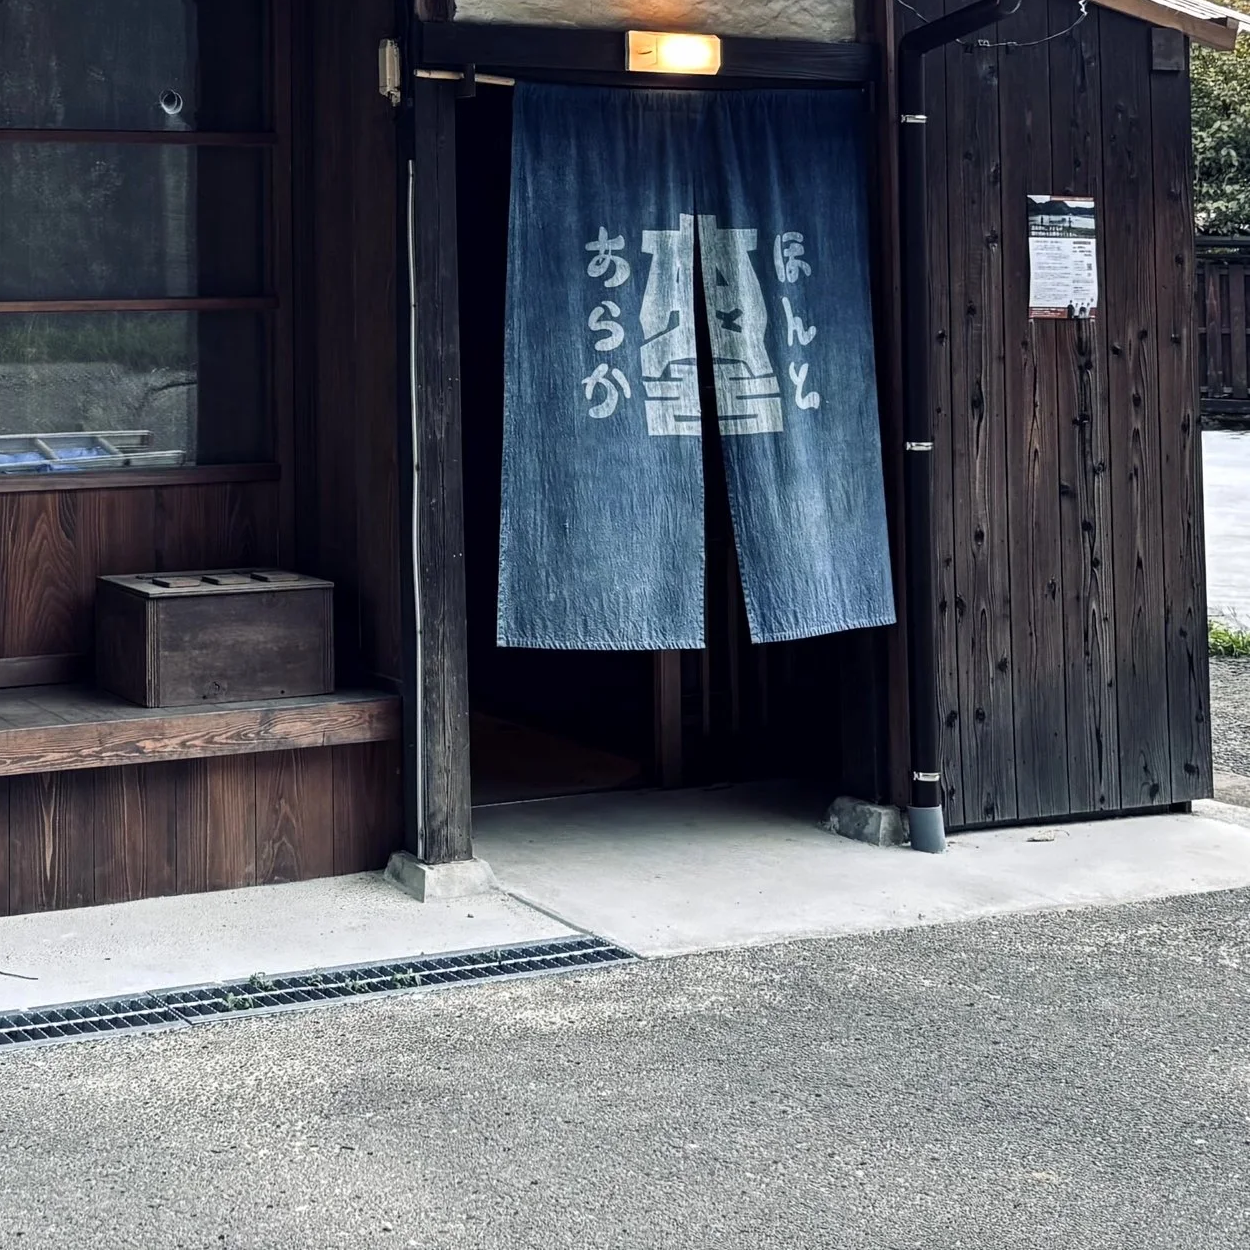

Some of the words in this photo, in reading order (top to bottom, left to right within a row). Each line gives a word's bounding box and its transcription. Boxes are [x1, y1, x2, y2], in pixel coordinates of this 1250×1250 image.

[582, 226, 631, 419] あらか
[773, 231, 820, 410] ほんと
